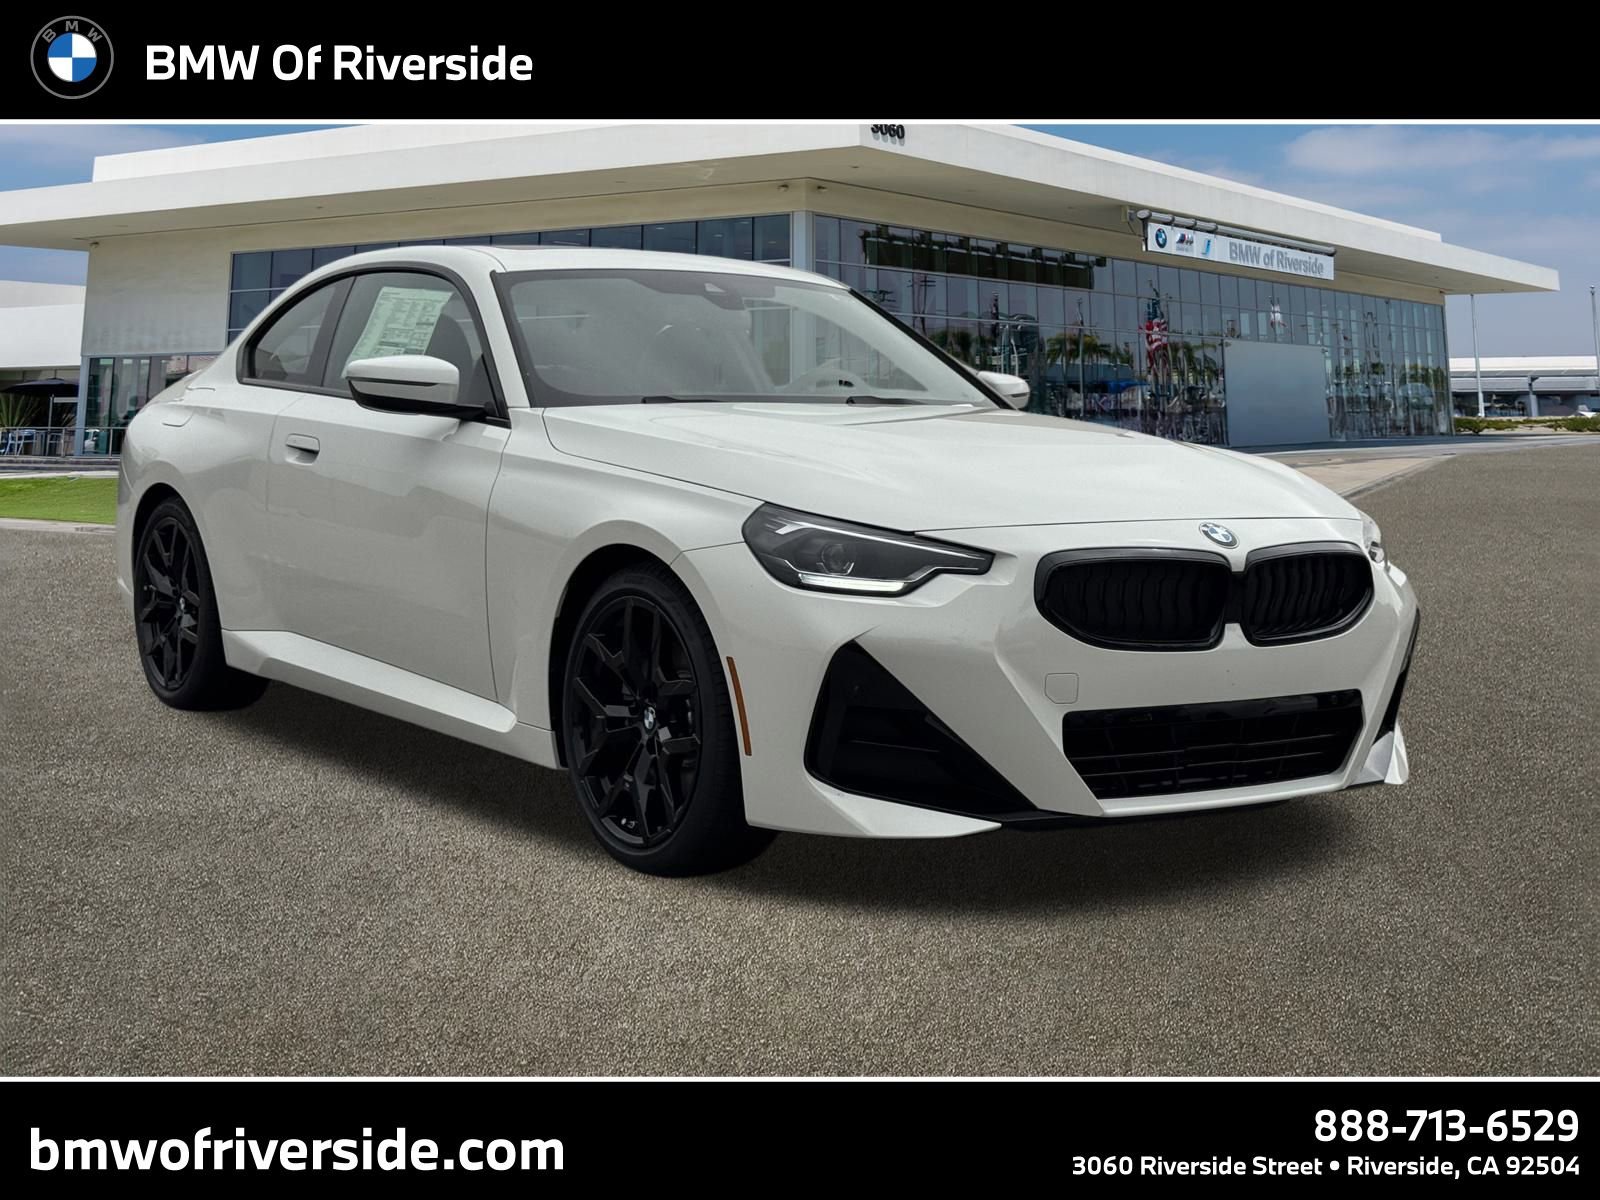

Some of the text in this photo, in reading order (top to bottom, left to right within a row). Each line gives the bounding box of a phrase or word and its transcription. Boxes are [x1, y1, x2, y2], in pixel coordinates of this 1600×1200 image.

[1229, 242, 1261, 264] BMW
[1263, 250, 1275, 267] of
[1276, 250, 1324, 275] Riverside
